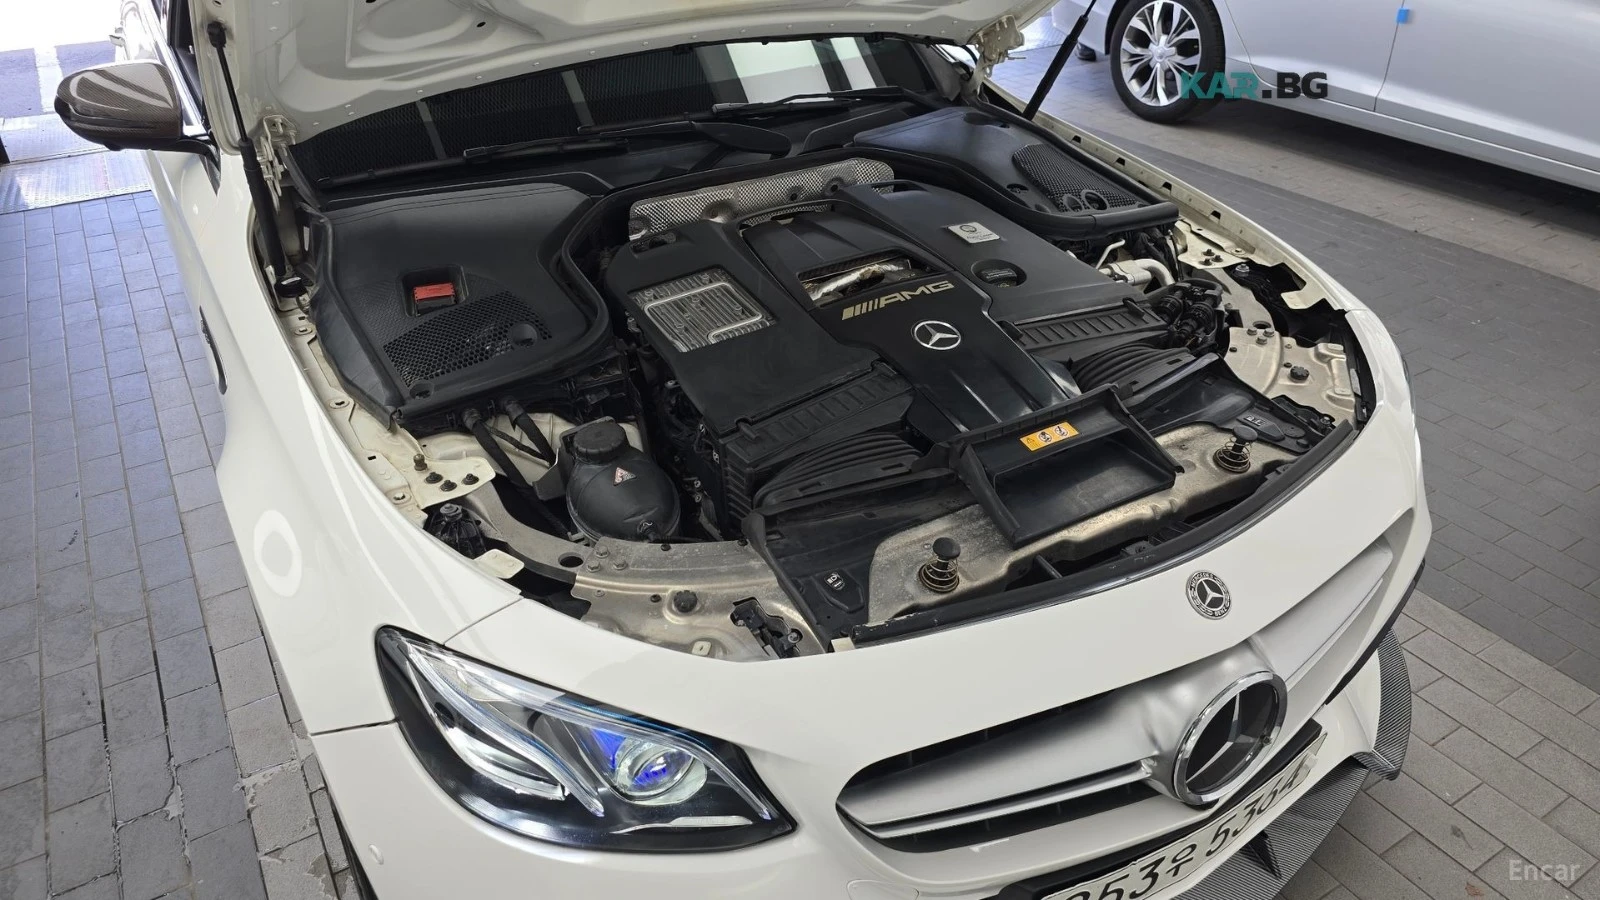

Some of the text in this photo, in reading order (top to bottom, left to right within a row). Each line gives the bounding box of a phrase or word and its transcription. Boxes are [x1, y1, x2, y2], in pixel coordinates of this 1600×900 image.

[879, 280, 955, 309] AMG
[1066, 754, 1308, 900] 53우 5364
